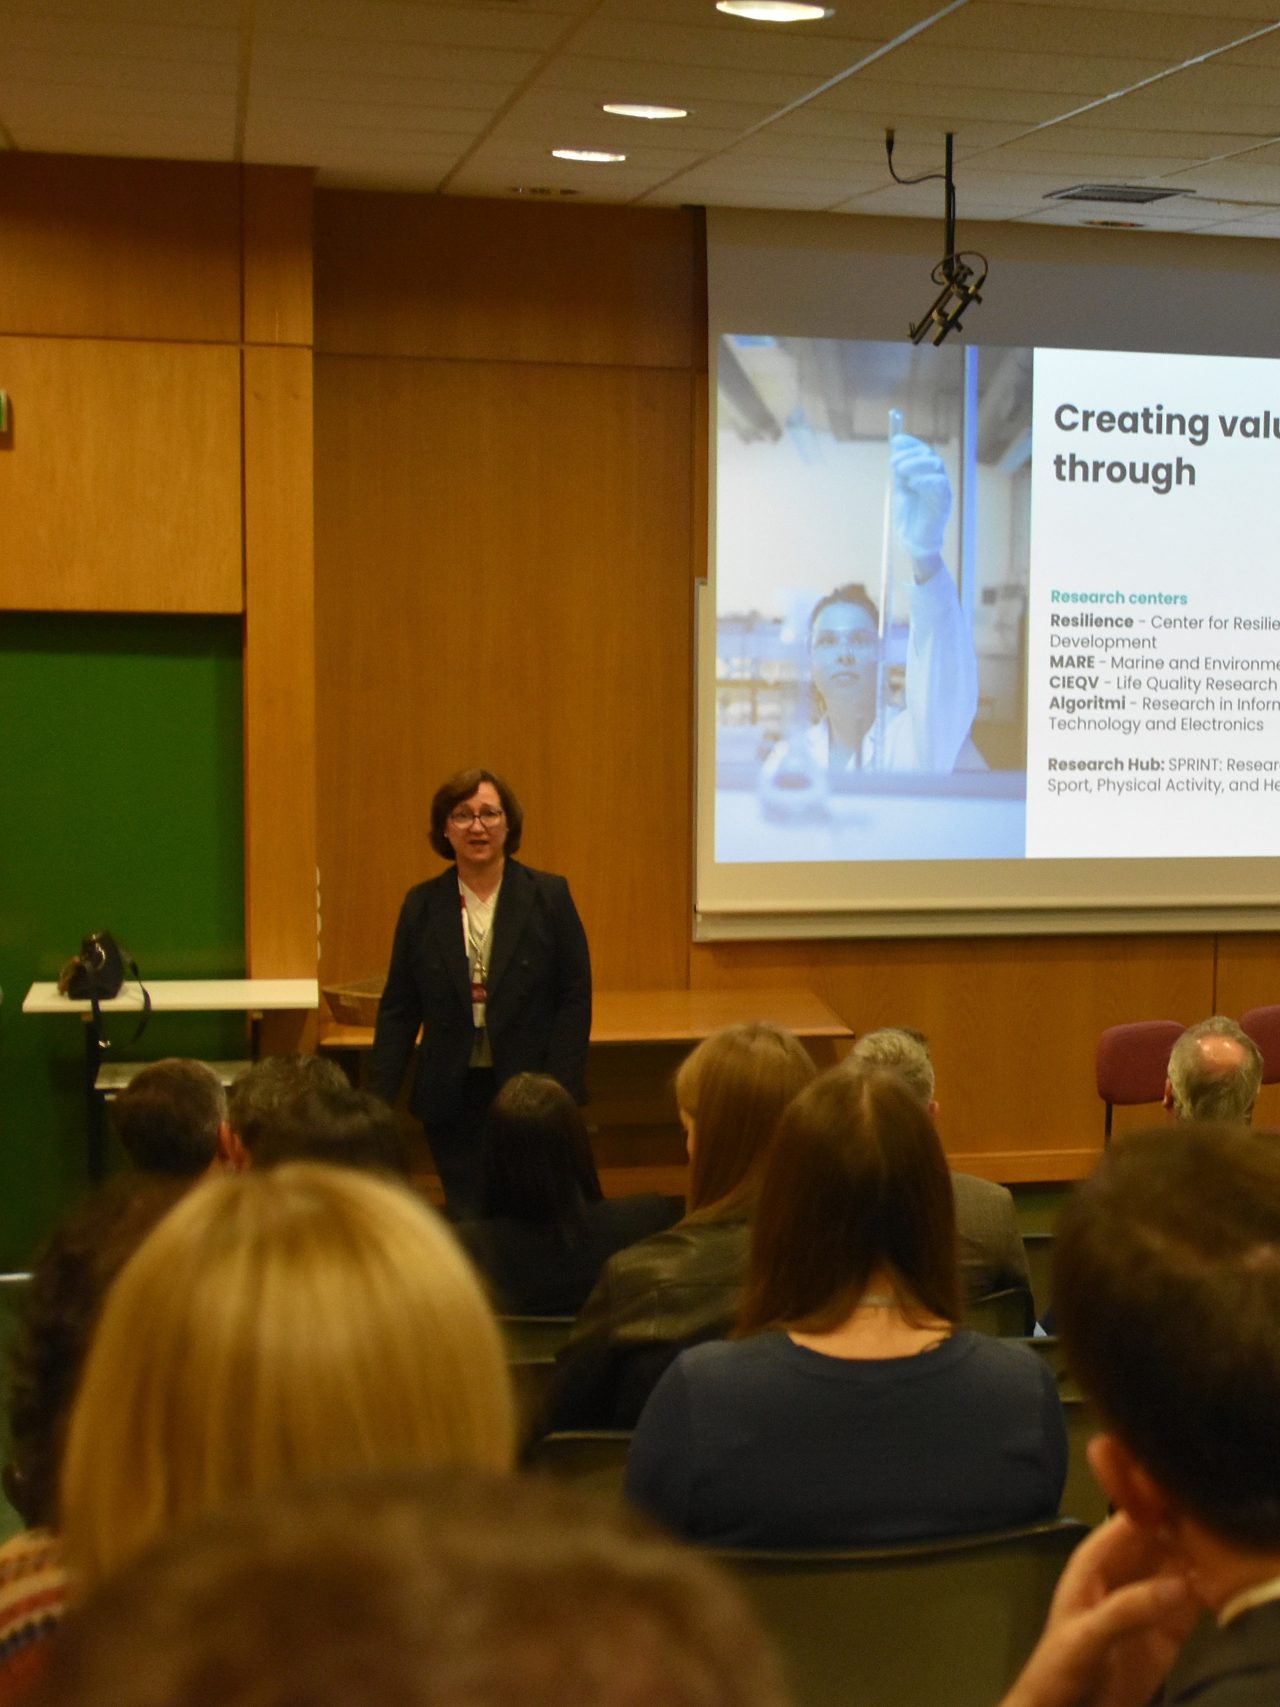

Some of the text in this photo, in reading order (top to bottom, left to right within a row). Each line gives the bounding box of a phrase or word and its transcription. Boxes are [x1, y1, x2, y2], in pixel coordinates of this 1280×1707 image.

[1054, 403, 1209, 446] Creating
[1053, 452, 1196, 495] through
[1051, 589, 1188, 606] Research centers
[1051, 612, 1134, 628] Resilience
[1151, 615, 1204, 629] Center
[1209, 615, 1229, 630] for
[1050, 634, 1157, 652] Development
[1050, 655, 1095, 669] MARE
[1111, 655, 1164, 670] Marine
[1169, 656, 1199, 670] and
[1049, 675, 1099, 691] CIEQV
[1117, 676, 1142, 690] Life
[1147, 676, 1201, 694] Quality
[1206, 677, 1277, 691] Research
[1049, 695, 1125, 714] Algoritmi
[1143, 697, 1214, 711] Research
[1220, 697, 1232, 711] in
[1049, 716, 1264, 735] Technology and Electronics
[1048, 757, 1124, 771] Research
[1128, 757, 1165, 771] Hub:
[1169, 758, 1222, 771] SPRINT:
[1048, 778, 1092, 796] Sport,
[1097, 778, 1160, 796] Physical
[1166, 777, 1224, 795] Activity,
[1229, 778, 1259, 792] and
